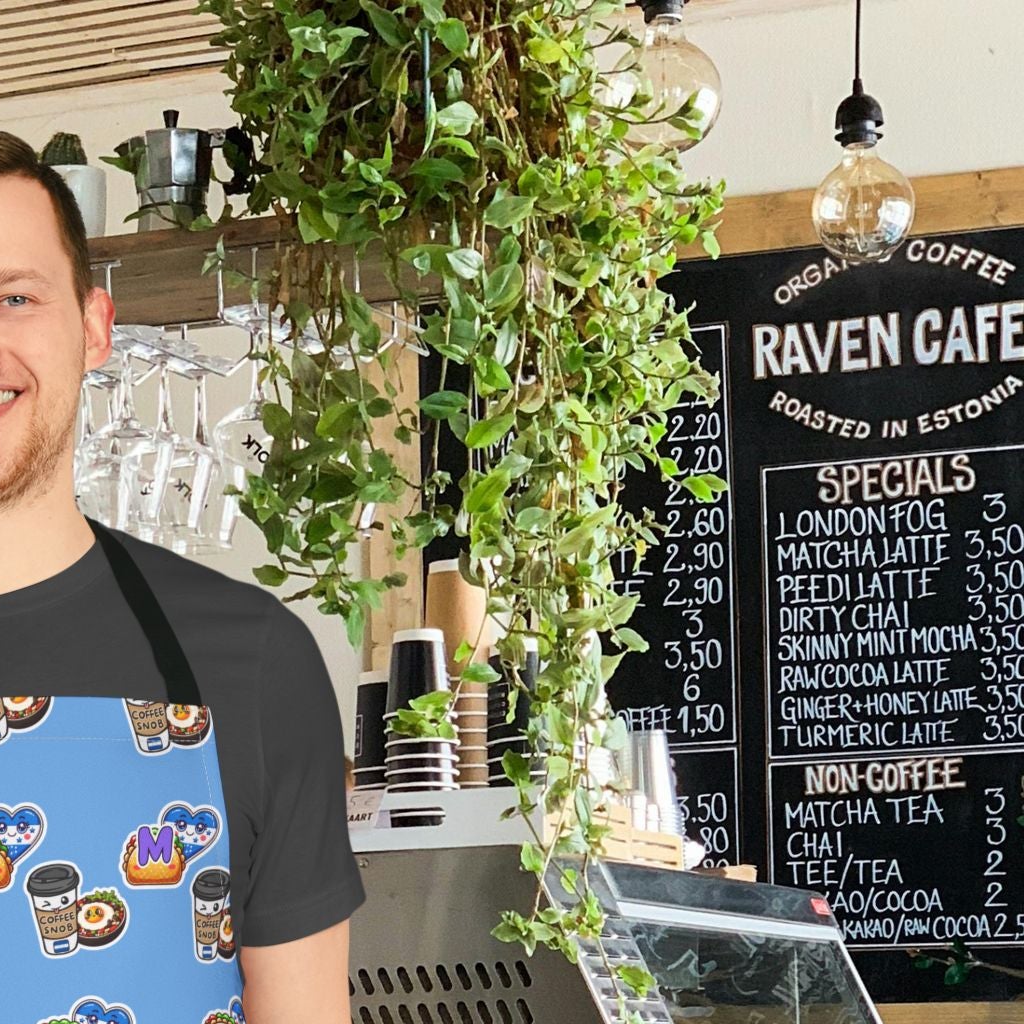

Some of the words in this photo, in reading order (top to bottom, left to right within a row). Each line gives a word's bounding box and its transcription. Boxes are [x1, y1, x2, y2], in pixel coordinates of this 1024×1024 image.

[906, 240, 1016, 285] COFFEE
[752, 312, 902, 380] RAVEN
[913, 299, 1024, 365] CAFE
[769, 390, 871, 439] ROASTED
[881, 419, 908, 439] IN
[917, 375, 1024, 434] ESTONIA
[667, 412, 721, 442] 2,20
[816, 453, 976, 504] SPECIALS
[664, 507, 725, 538] 2,60
[775, 504, 886, 540] LONDON
[889, 498, 948, 533] FOG
[983, 493, 1006, 522] 3
[663, 541, 724, 574] 2,90
[777, 538, 877, 571] MATCHA
[878, 533, 950, 568] LATTE
[964, 523, 1024, 560] 3,50
[663, 576, 723, 608] 2,90
[776, 573, 851, 604] PEEDI
[854, 567, 940, 601] LATTE
[966, 559, 1024, 593] 3,50
[682, 609, 703, 638] 3
[779, 605, 846, 632] DIRTY
[852, 600, 910, 630] CHAI
[968, 593, 1024, 624] 3,50
[665, 638, 722, 672] 3,50
[777, 631, 853, 661] SKINNY
[857, 628, 907, 657] MINT
[911, 623, 977, 654] MOCHA
[683, 673, 700, 701] 6
[894, 658, 951, 687] LATTE
[132, 707, 164, 720] COFFEE
[933, 686, 986, 713] LATTE
[137, 718, 164, 730] SNOB
[677, 703, 725, 738] 1,50
[778, 722, 898, 748] TURMERIC
[902, 718, 958, 745] LATTE
[676, 792, 727, 823] 3,50
[785, 797, 881, 829] MATCHA
[885, 793, 944, 825] TEA
[984, 787, 1005, 815] 3
[136, 825, 175, 867] M
[787, 831, 842, 859] CHAI
[986, 817, 1006, 845] 3
[786, 853, 903, 889] TEE/TEA
[984, 850, 1006, 876] 2
[984, 882, 1008, 907] 2
[40, 914, 75, 925] COFFEE
[45, 923, 73, 934] SNOB
[196, 920, 218, 929] COFFEE
[198, 930, 216, 939] SNOB
[932, 914, 991, 939] COCOA
